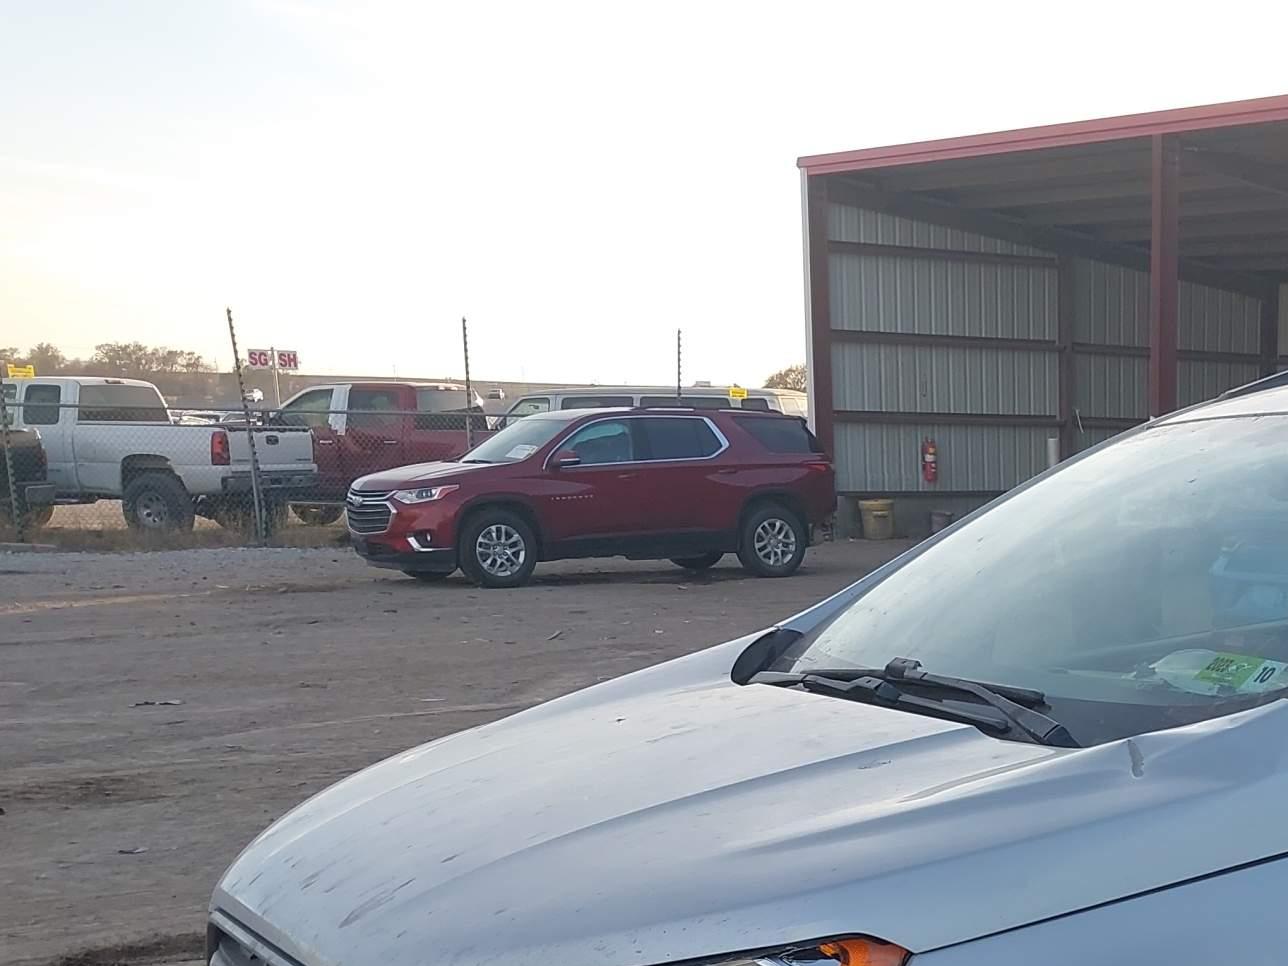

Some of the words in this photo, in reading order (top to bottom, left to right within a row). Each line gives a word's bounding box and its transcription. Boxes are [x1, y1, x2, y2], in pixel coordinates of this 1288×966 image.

[249, 351, 269, 366] SG
[278, 353, 298, 368] SH
[1253, 666, 1276, 684] 10
